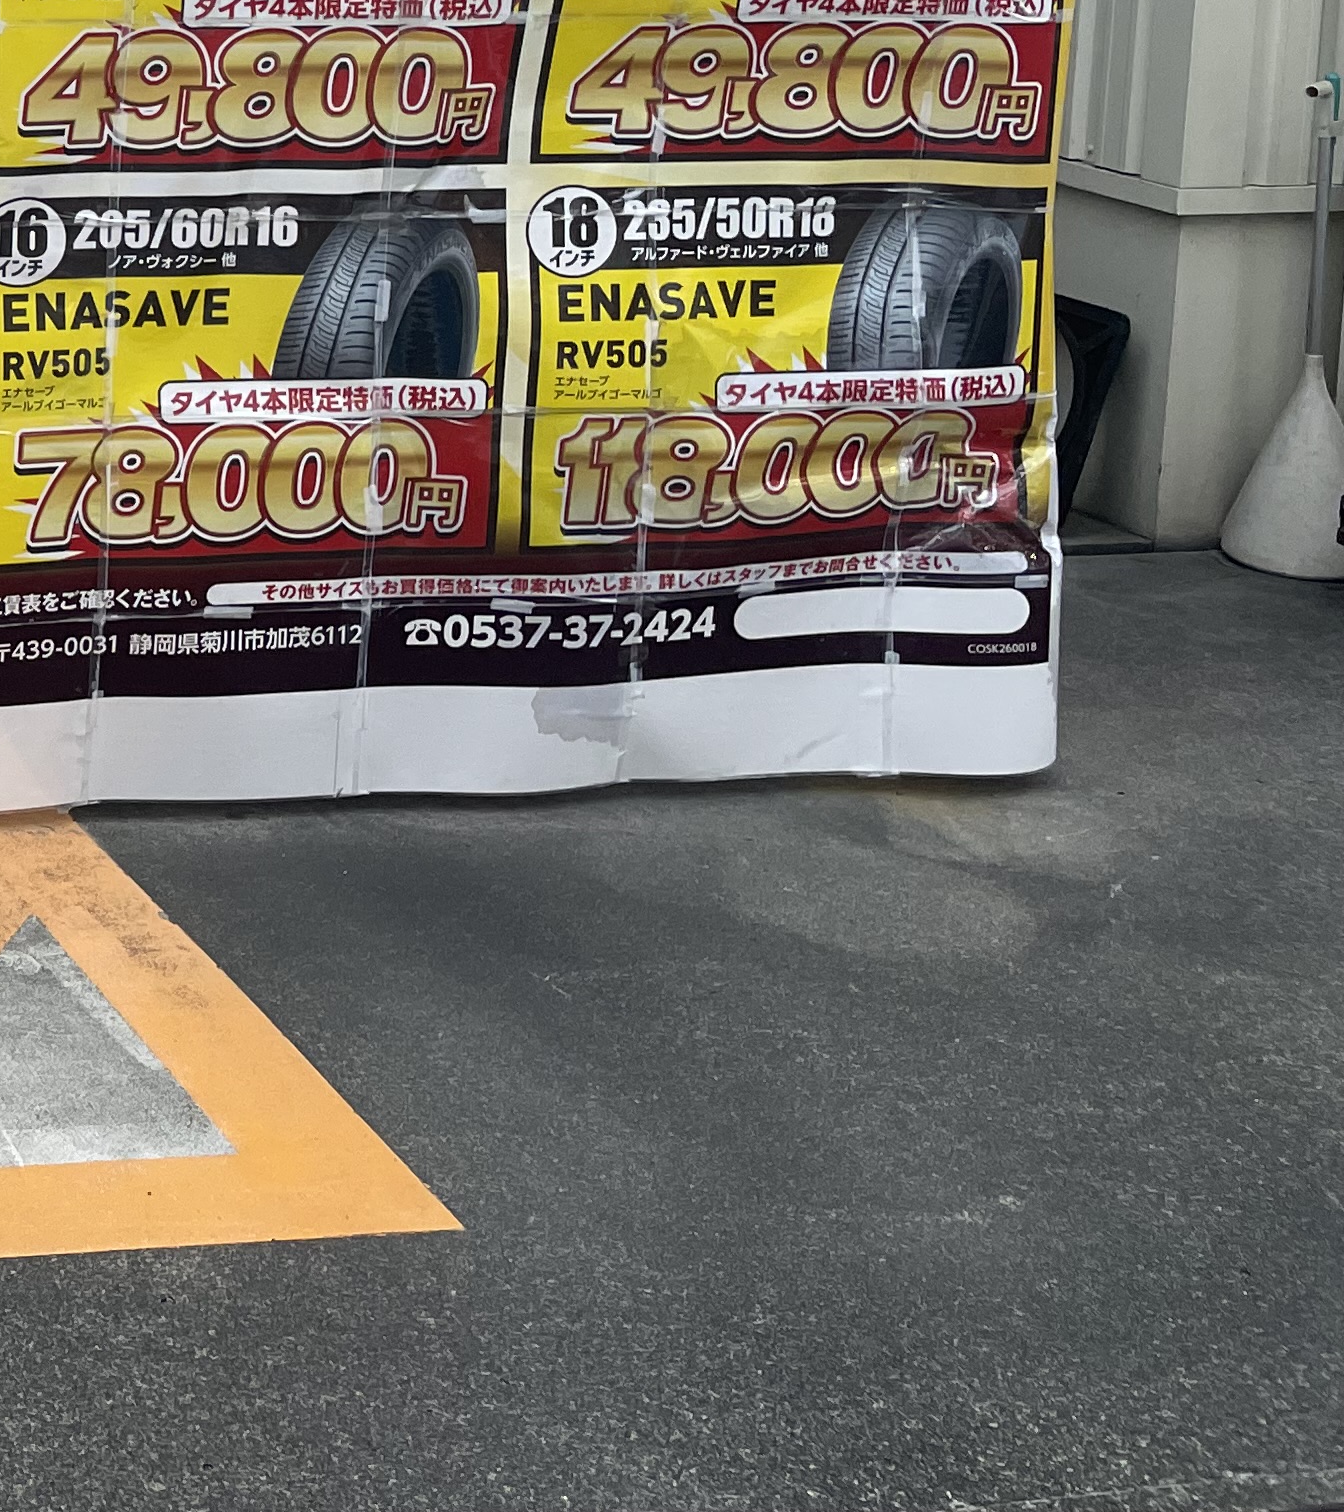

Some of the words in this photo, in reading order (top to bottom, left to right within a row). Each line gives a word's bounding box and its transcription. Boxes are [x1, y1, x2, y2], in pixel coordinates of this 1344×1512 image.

[20, 29, 493, 147] 49,800円
[568, 23, 1040, 141] 49,800円
[73, 205, 299, 250] 205/60R16
[542, 196, 599, 248] 18
[222, 252, 236, 268] 他
[549, 248, 596, 268] インチ
[814, 243, 829, 258] 他
[3, 288, 230, 333] ENASAVE
[558, 280, 776, 322] ENASAVE
[3, 348, 110, 380] RV505
[557, 340, 667, 370] RV505
[2, 386, 55, 398] エナセーブ
[554, 376, 610, 387] エナセーブ
[725, 374, 1018, 406] タイヤ4本限定特価(税込)
[171, 383, 478, 414] タイヤ4本限定特価(税込)
[16, 418, 466, 548] 78,000円
[558, 410, 997, 530] 118,000円
[129, 624, 362, 656] 静岡県菊川市加茂6112
[968, 642, 1038, 656] COSK260018
